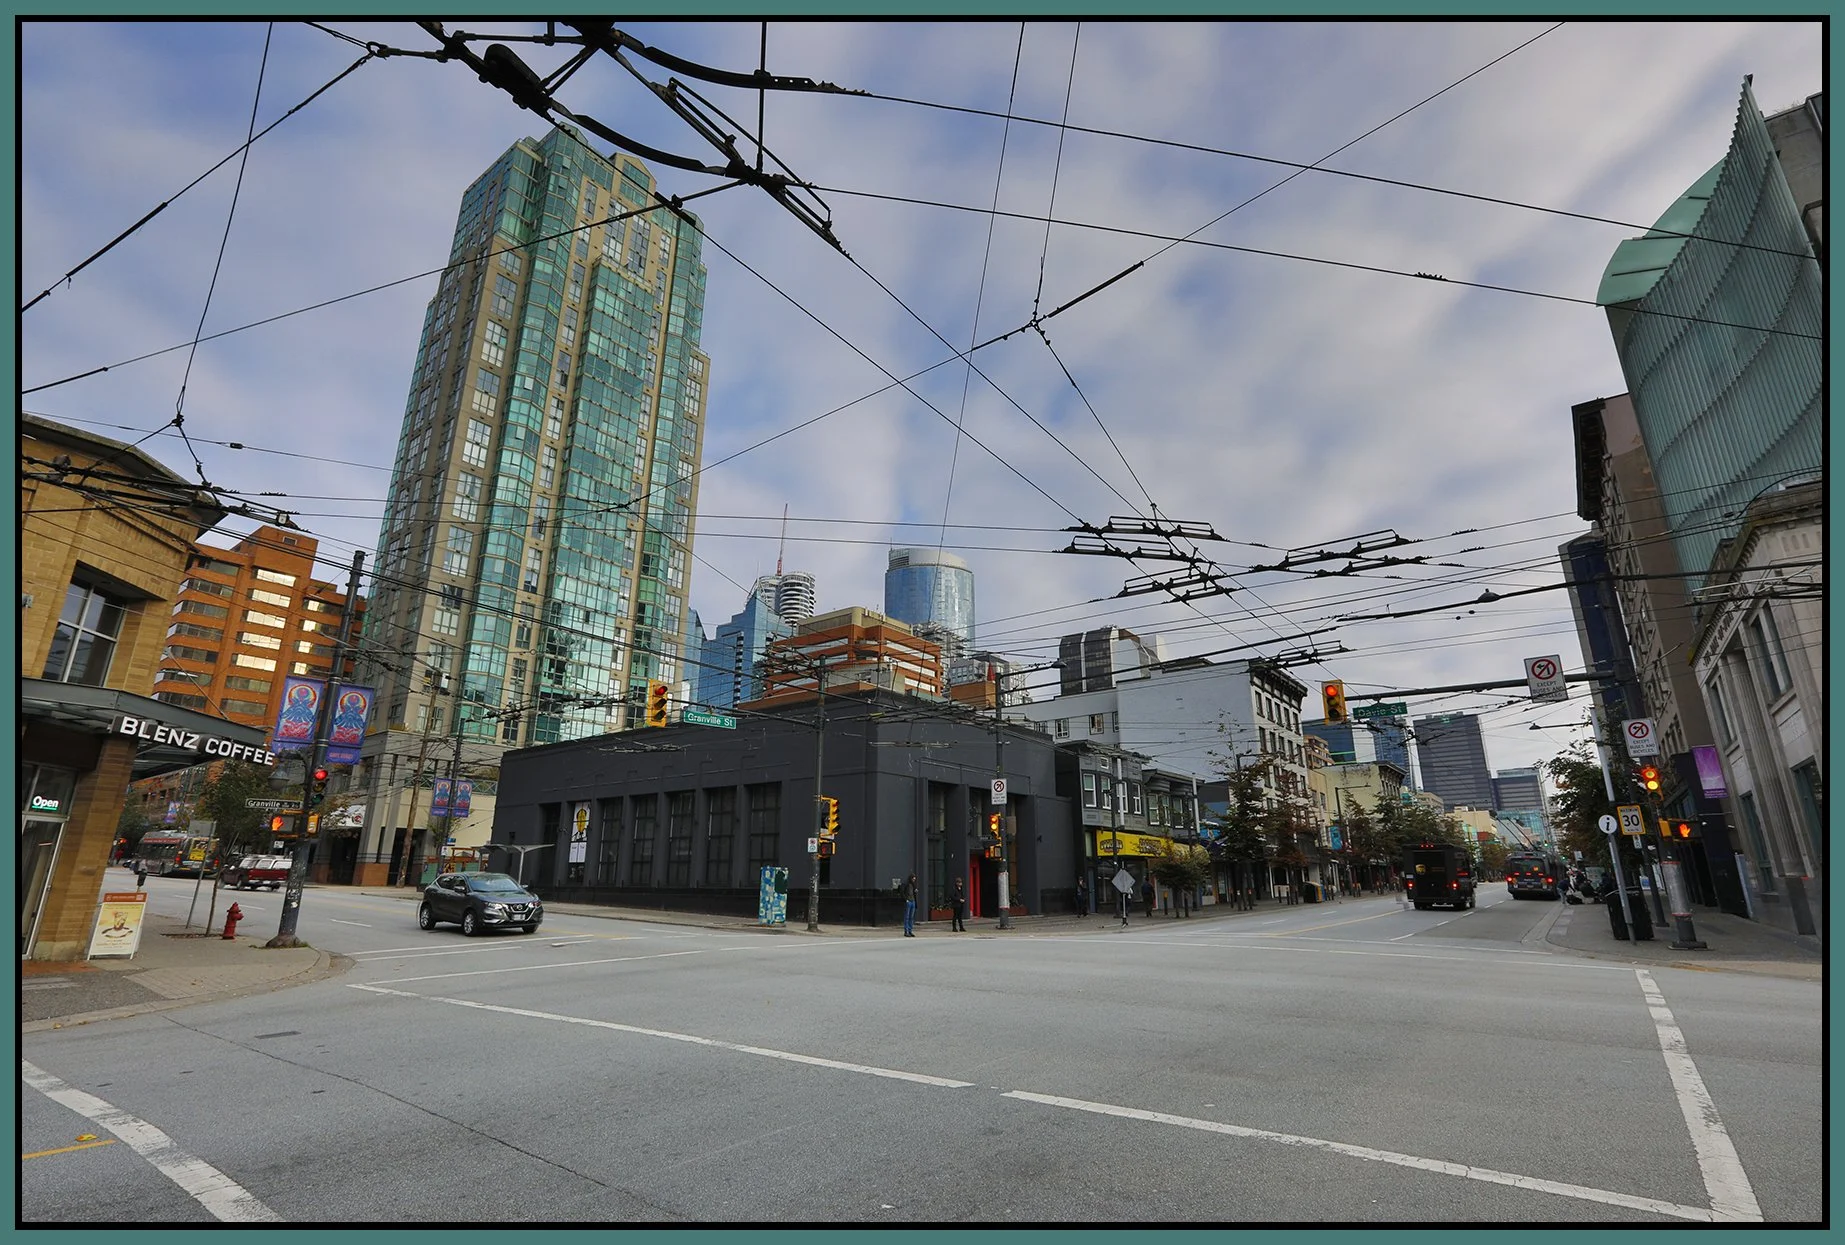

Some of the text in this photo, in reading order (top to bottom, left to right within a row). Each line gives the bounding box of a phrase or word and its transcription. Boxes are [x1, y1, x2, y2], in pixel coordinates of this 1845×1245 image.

[1358, 705, 1402, 717] Davie St
[688, 713, 721, 724] Granville
[120, 716, 276, 766] BLENZ COFFEE
[33, 796, 59, 808] Open
[1622, 815, 1640, 826] 30
